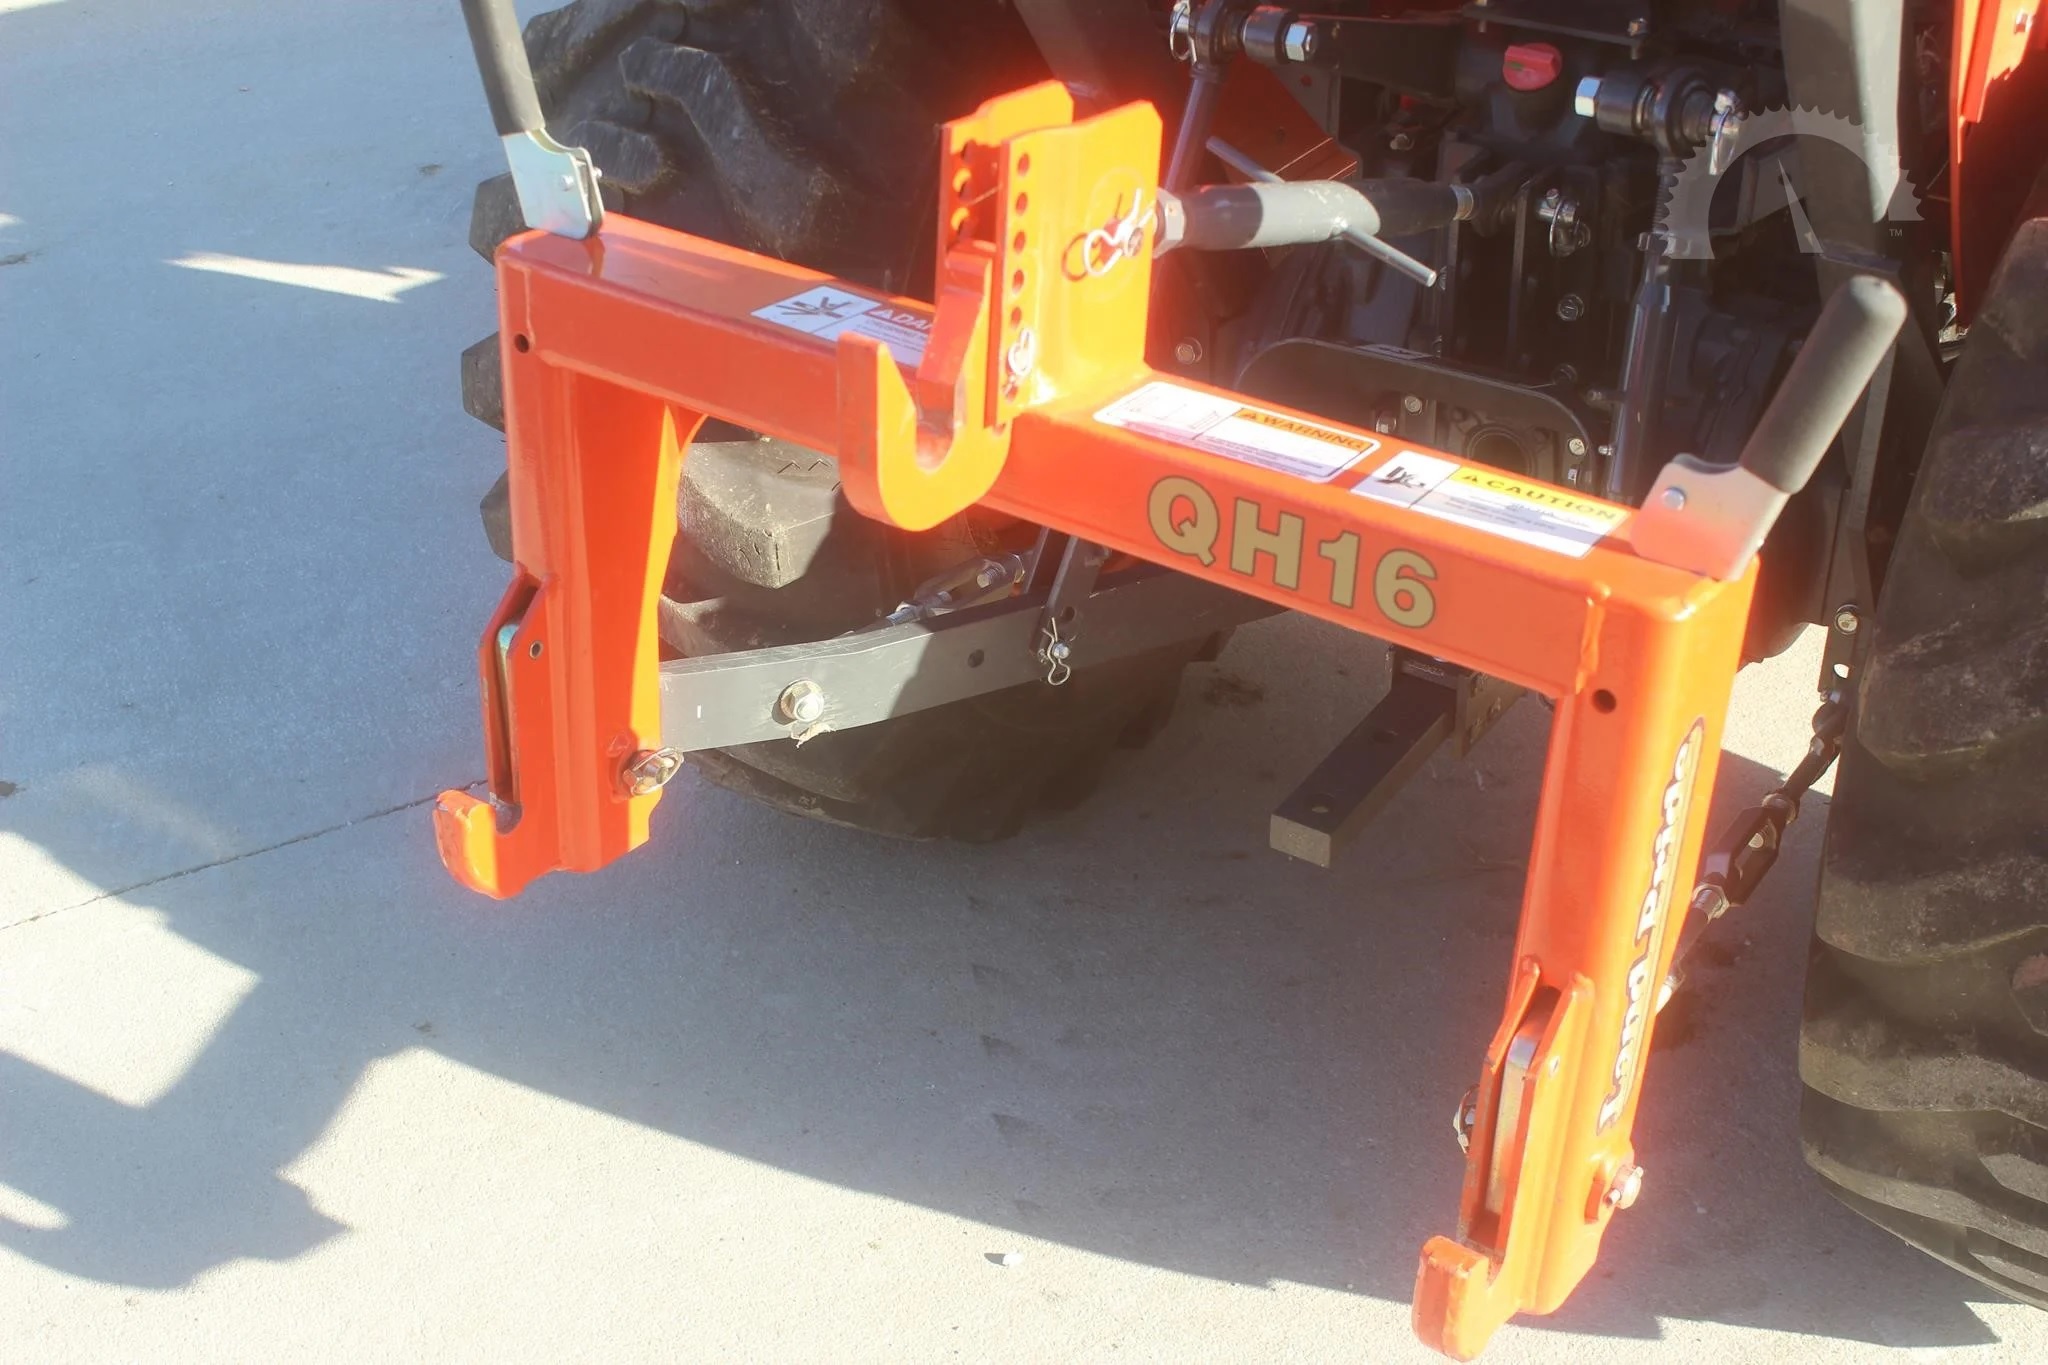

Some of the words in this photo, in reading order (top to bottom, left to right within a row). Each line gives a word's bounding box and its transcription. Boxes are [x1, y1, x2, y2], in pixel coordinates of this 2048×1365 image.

[1263, 414, 1363, 449] WARNING
[1486, 479, 1617, 520] CAUTION
[1147, 475, 1439, 629] QH16
[1597, 953, 1649, 1136] Land
[1635, 736, 1693, 945] Pride
